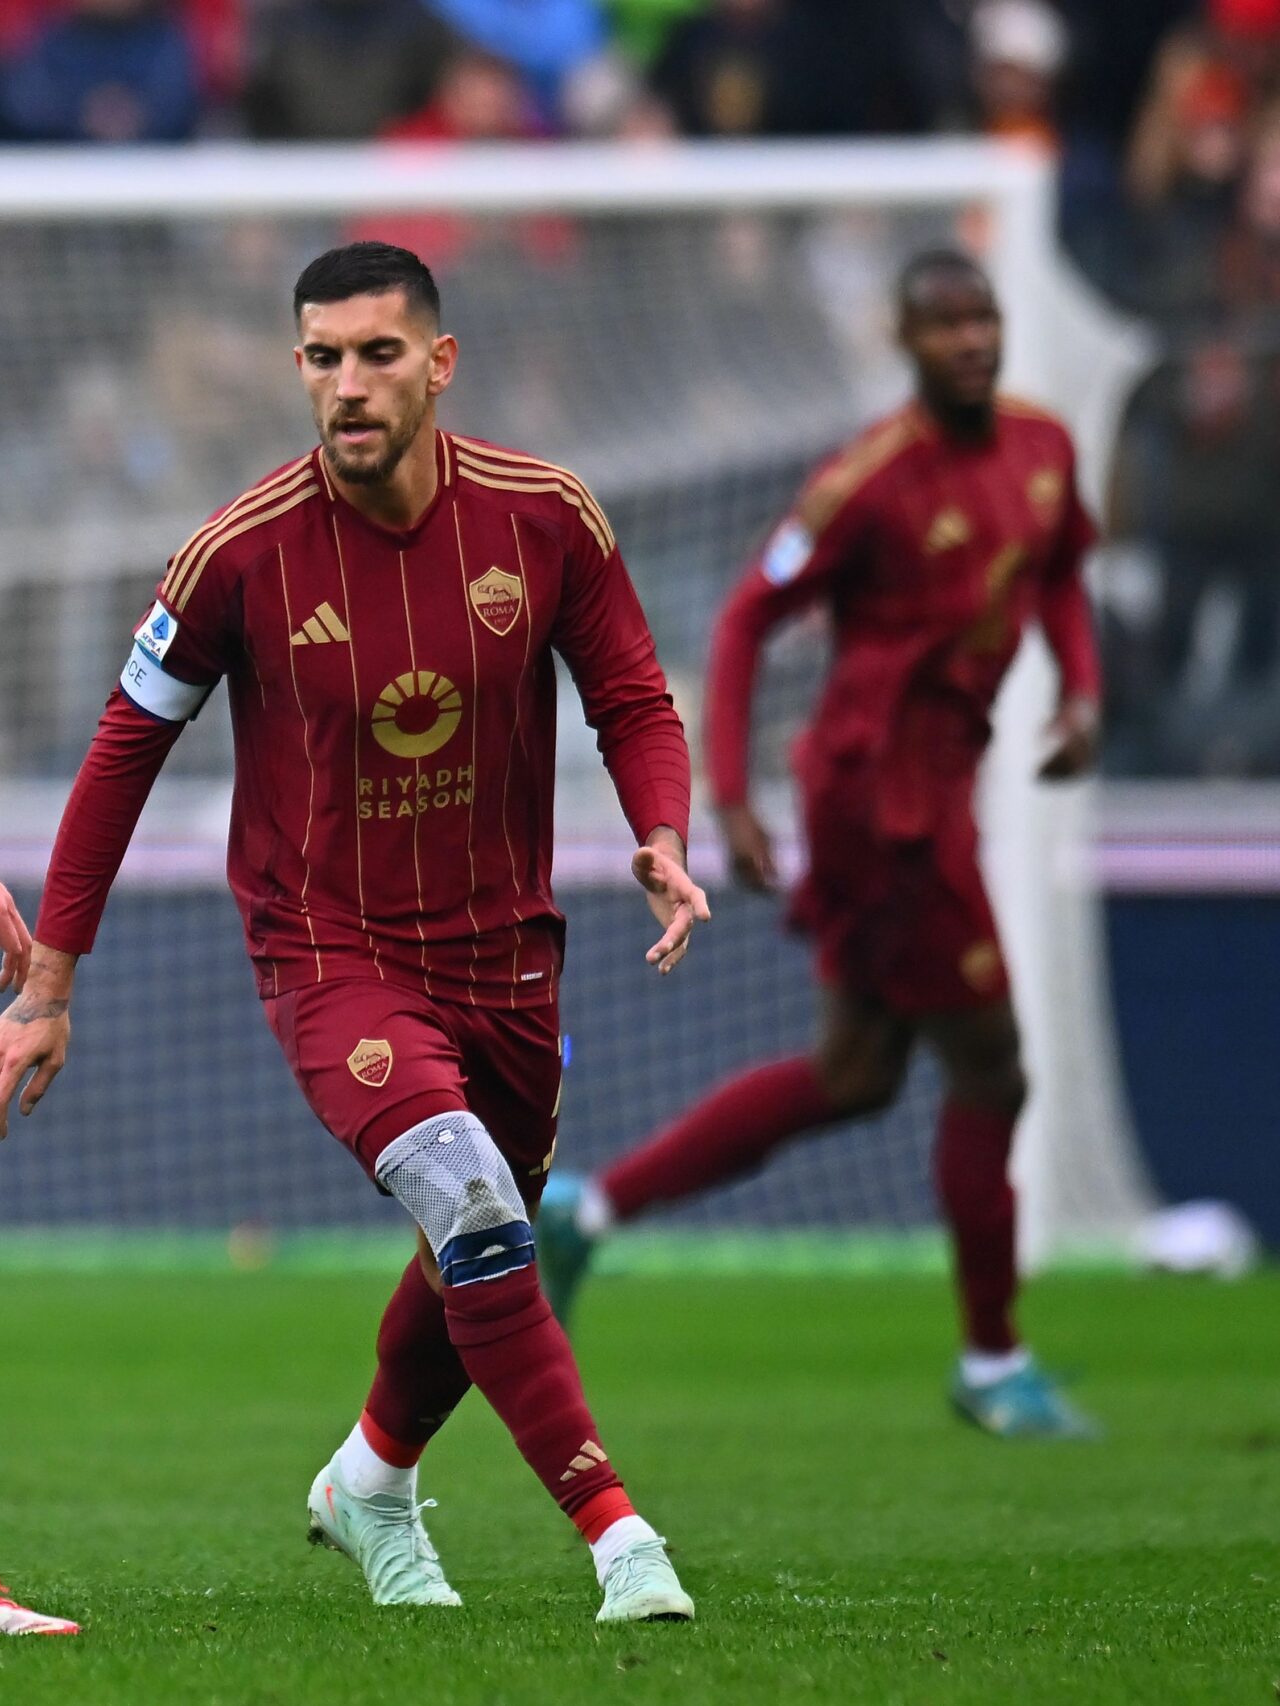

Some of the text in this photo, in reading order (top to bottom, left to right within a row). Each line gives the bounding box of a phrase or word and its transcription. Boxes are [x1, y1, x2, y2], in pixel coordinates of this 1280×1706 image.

[483, 605, 515, 617] ROMA
[141, 632, 157, 648] SERIE
[358, 765, 473, 796] RIYADH
[358, 787, 472, 819] SEASON
[361, 1062, 387, 1080] ROMA
